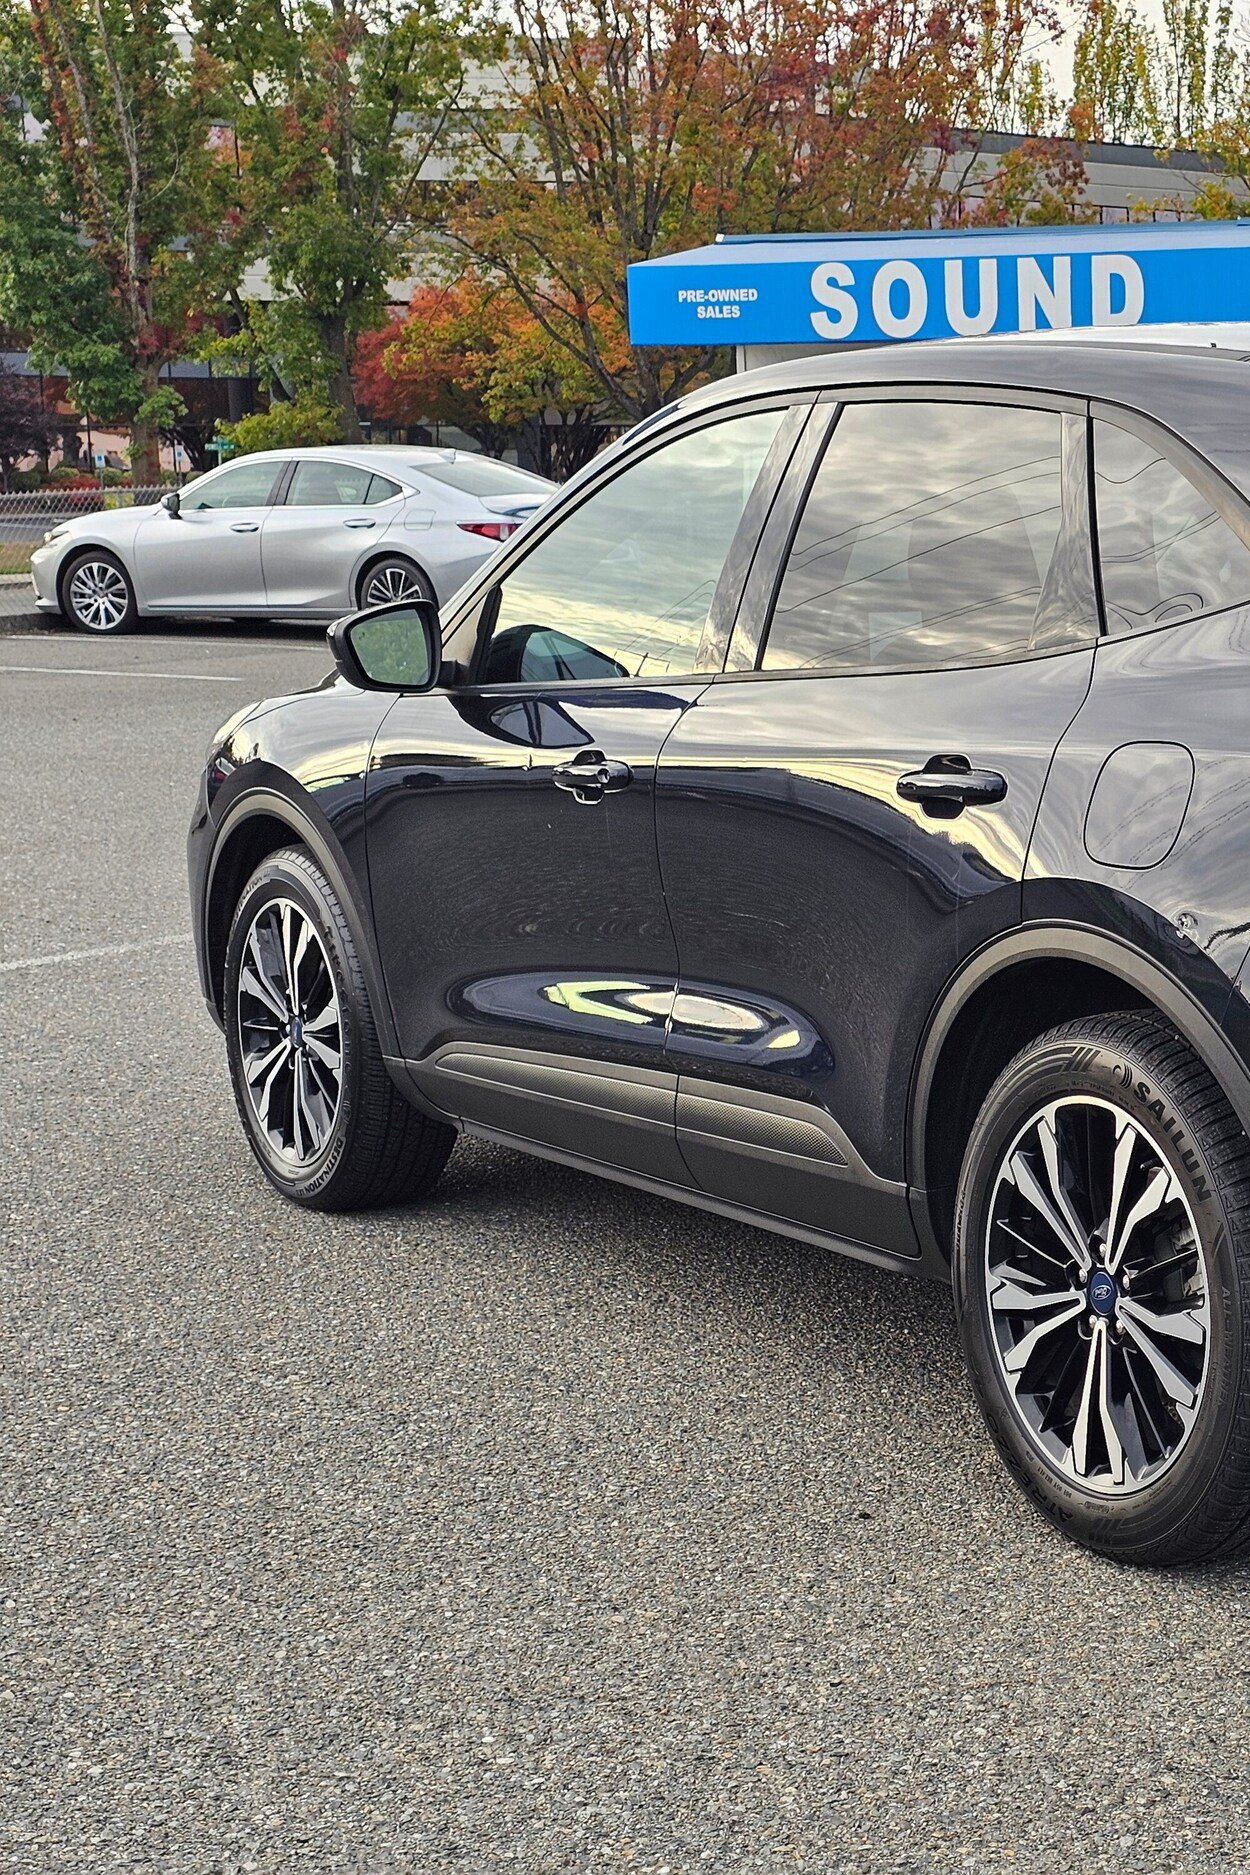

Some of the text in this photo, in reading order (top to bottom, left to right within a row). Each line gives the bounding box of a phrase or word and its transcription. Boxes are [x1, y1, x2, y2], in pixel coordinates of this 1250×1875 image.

[678, 288, 758, 303] PRE-OWNED
[697, 305, 741, 318] SALES
[810, 254, 1144, 340] SOUND
[304, 1137, 344, 1194] DESTINATION
[1133, 1081, 1212, 1203] SAILUN
[986, 1412, 1074, 1523] ATREZZO
